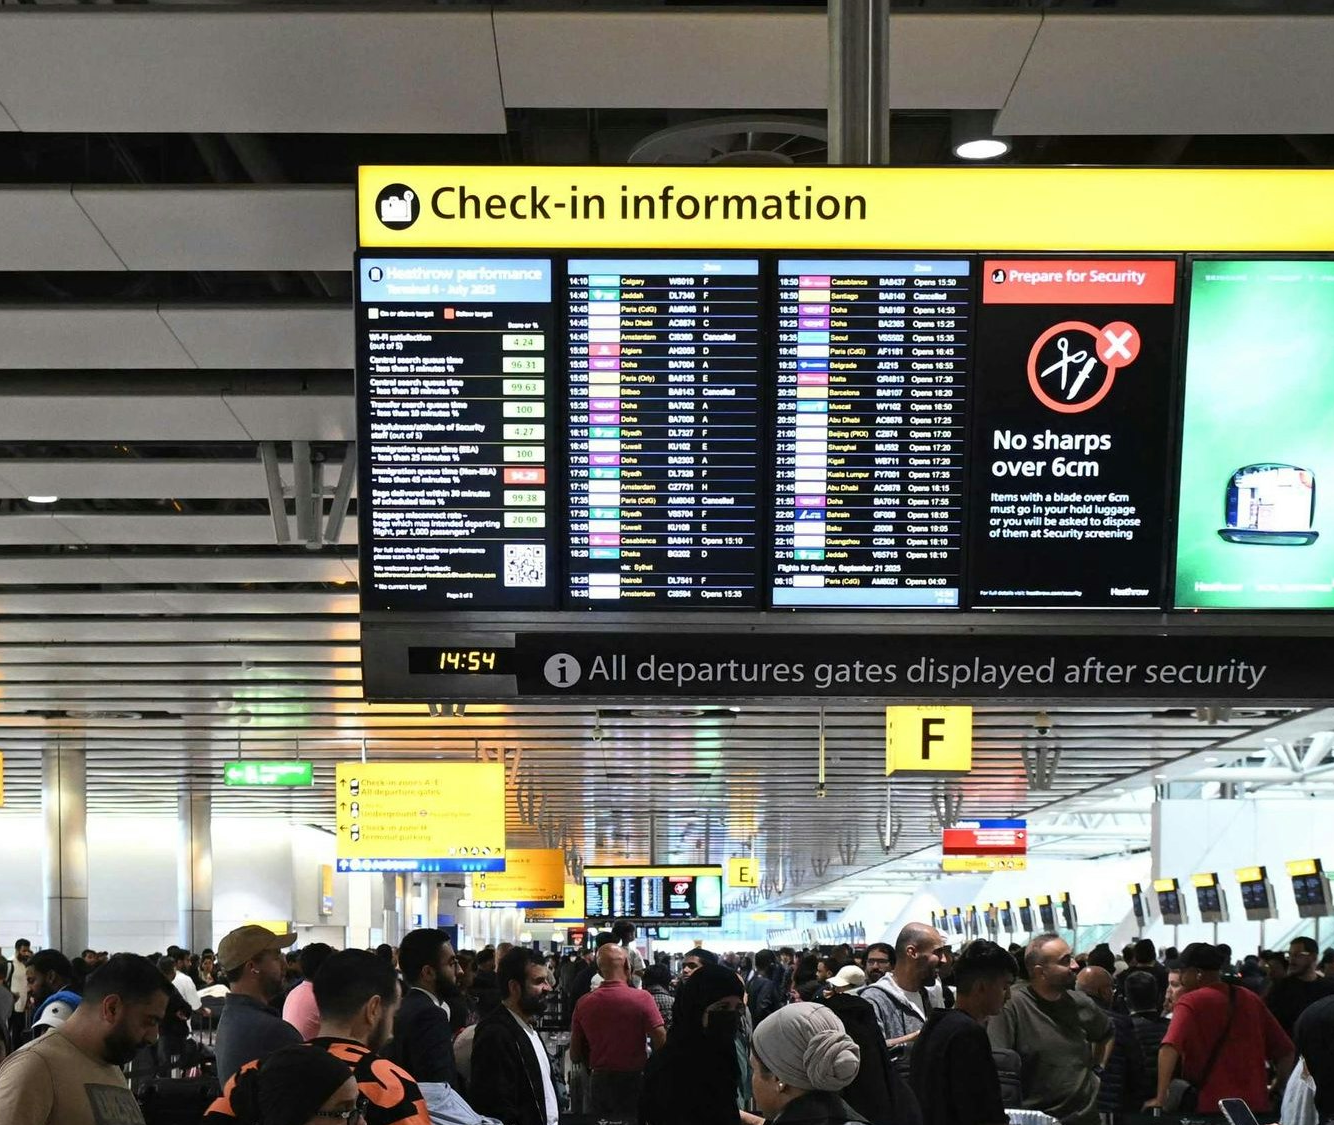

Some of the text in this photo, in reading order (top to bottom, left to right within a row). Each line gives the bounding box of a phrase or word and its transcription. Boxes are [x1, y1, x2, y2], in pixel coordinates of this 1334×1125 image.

[431, 185, 866, 221] Check-in information
[387, 267, 542, 282] Heathrow performance
[1009, 270, 1145, 284] Prepare for Security
[514, 428, 534, 436] 4.27
[993, 430, 1111, 455] No sharps
[992, 457, 1099, 477] over 6cm
[991, 493, 1019, 502] Items
[1020, 493, 1043, 502] with
[1054, 493, 1082, 502] blade
[1109, 493, 1129, 502] 6cm
[990, 505, 1135, 516] must go in your hold luggage
[990, 517, 1141, 528] or you will be asked to dispose
[989, 529, 1133, 540] of them at Security screening
[1111, 588, 1149, 596] Heathrow
[440, 651, 495, 671] 14:54
[589, 655, 1267, 690] All departures gates displayed after security
[922, 718, 945, 759] F
[739, 867, 749, 882] E
